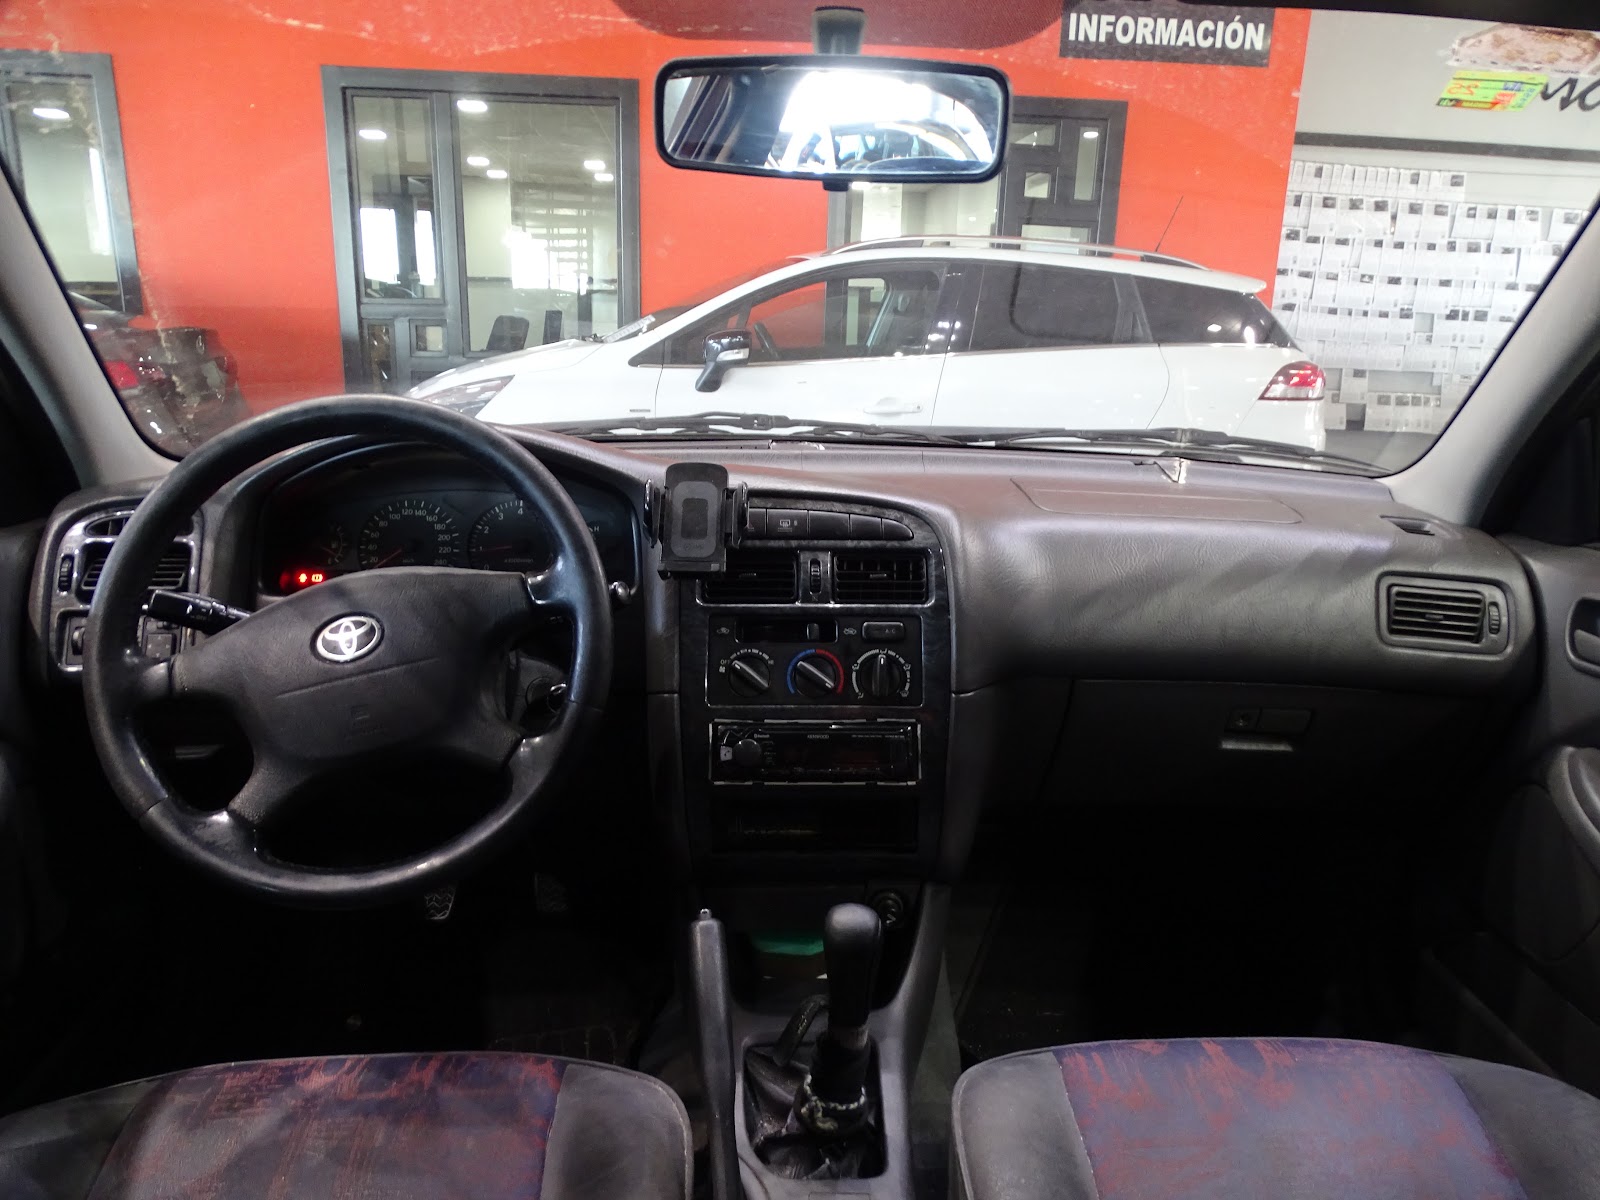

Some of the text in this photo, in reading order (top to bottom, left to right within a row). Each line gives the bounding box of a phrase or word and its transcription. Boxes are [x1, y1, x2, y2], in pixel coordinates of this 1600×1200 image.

[1068, 12, 1266, 50] INFORMACIÓN
[517, 507, 523, 515] 4
[484, 526, 490, 534] 2
